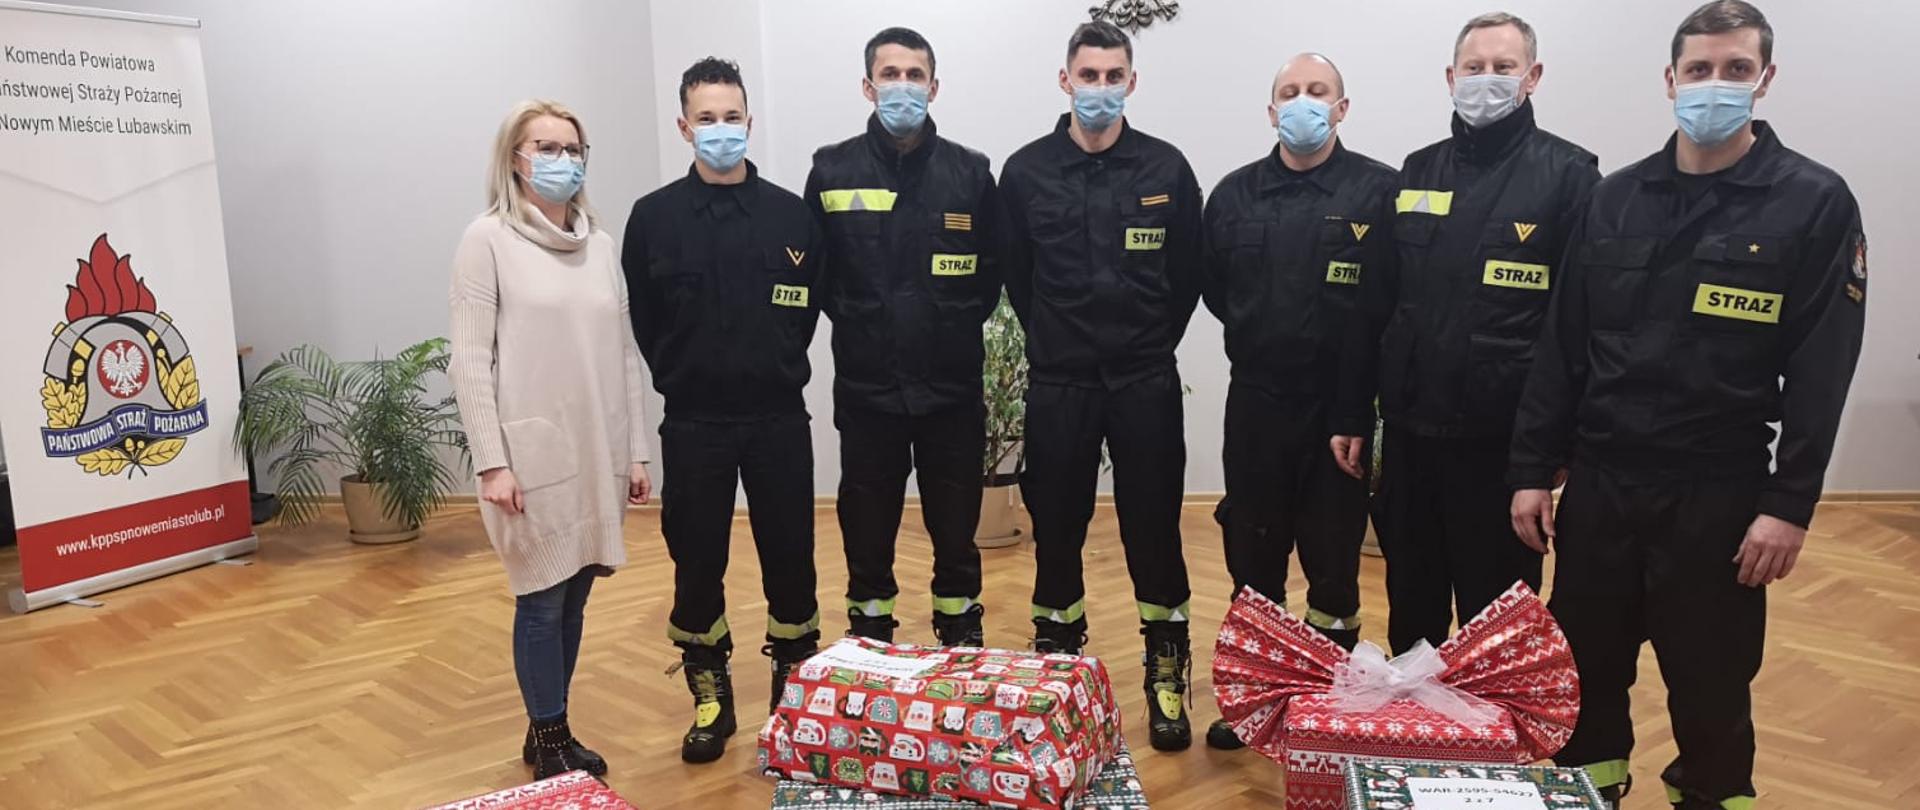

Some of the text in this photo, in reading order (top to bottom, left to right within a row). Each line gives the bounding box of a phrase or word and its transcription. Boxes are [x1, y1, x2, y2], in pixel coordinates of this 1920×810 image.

[5, 45, 155, 72] Komenda Powiatowa
[78, 83, 120, 105] Straży
[125, 86, 182, 108] Pożarnej
[0, 113, 192, 136] Nowym Mieście Lubawskim
[1333, 266, 1357, 280] STR
[47, 409, 204, 452] PAŃSTWOWA STRAŻ POŻARNA
[56, 504, 225, 556] www.kppspnowemiastolub.pl
